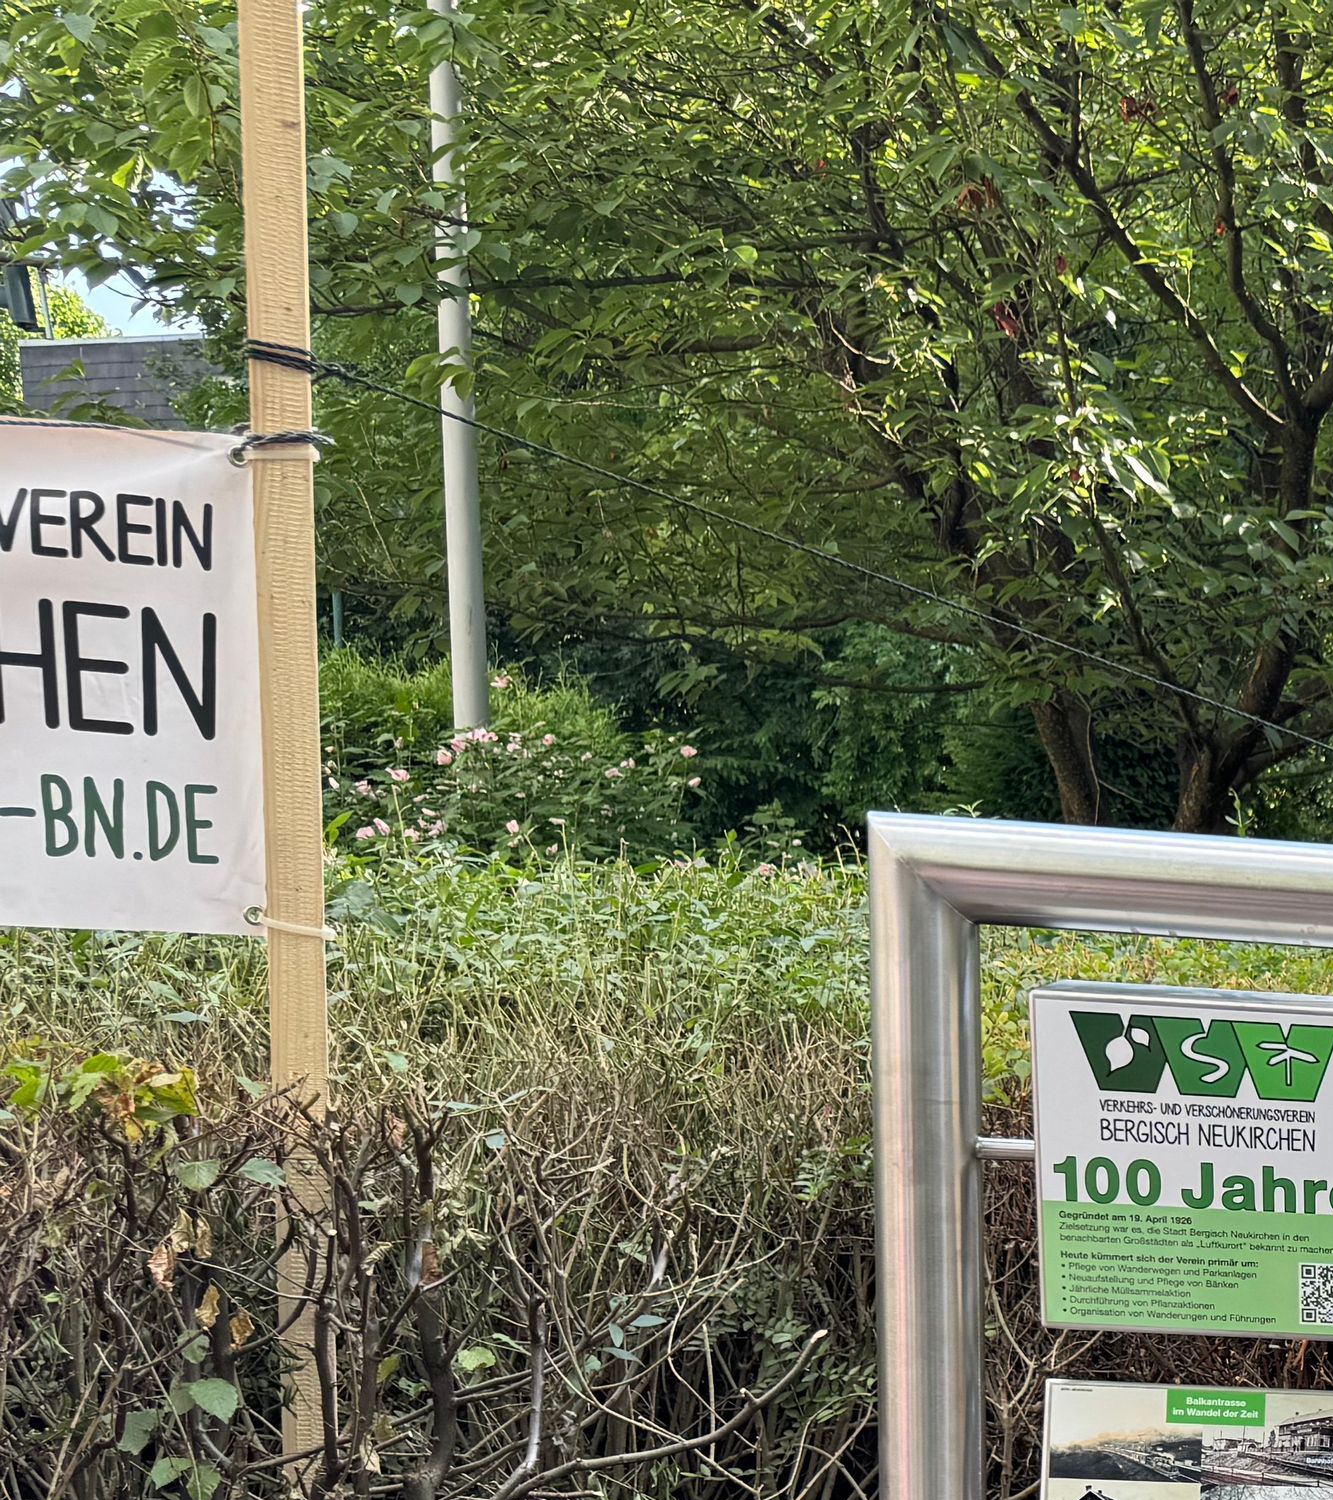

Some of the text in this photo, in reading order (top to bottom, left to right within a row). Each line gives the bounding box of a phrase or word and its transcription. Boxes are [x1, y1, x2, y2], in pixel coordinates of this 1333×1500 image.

[1099, 1099, 1316, 1123] VERKEHRS- UND VERSCHÖNERUNGSVEREIN
[1100, 1118, 1316, 1152] BERGISCH NEUKIRCHEN
[1053, 1155, 1162, 1206] 100
[1059, 1211, 1109, 1221] Gegründet
[1146, 1215, 1167, 1225] April
[1171, 1217, 1192, 1225] 1926
[1060, 1222, 1110, 1233] Zielsetzung
[1147, 1227, 1161, 1235] die
[1163, 1227, 1187, 1236] Stadt
[1190, 1228, 1228, 1239] Bergisch
[1231, 1230, 1279, 1240] Neukirchen
[1282, 1233, 1290, 1241] in
[1293, 1234, 1310, 1242] den
[1060, 1233, 1121, 1244] benachbarten
[1124, 1236, 1179, 1246] Großstädten
[1181, 1238, 1194, 1247] als
[1250, 1242, 1285, 1252] bekannt
[1287, 1245, 1297, 1253] zu
[1060, 1250, 1259, 1268] Heute kümmert sich der Verein primär um:
[1069, 1262, 1097, 1272] Pflege
[1118, 1264, 1181, 1276] Wanderwegen
[1183, 1267, 1200, 1276] und
[1203, 1268, 1257, 1280] Parkanlagen
[1069, 1273, 1135, 1286] Neuaufstellung
[1137, 1276, 1154, 1285] und
[1157, 1277, 1185, 1288] Pflege
[1205, 1280, 1239, 1289] Bänken
[1069, 1285, 1191, 1298] Jährliche Müllsammelaktion
[1070, 1295, 1129, 1307] Durchführung
[1151, 1299, 1215, 1310] Pflanzaktionen
[1070, 1306, 1126, 1317] Organisation
[1146, 1310, 1208, 1322] Wanderungen
[1210, 1313, 1227, 1322] und
[1230, 1314, 1276, 1325] Führungen
[1186, 1397, 1247, 1407] Balkantrasse
[1172, 1407, 1259, 1418] im Wandel der Zeit
